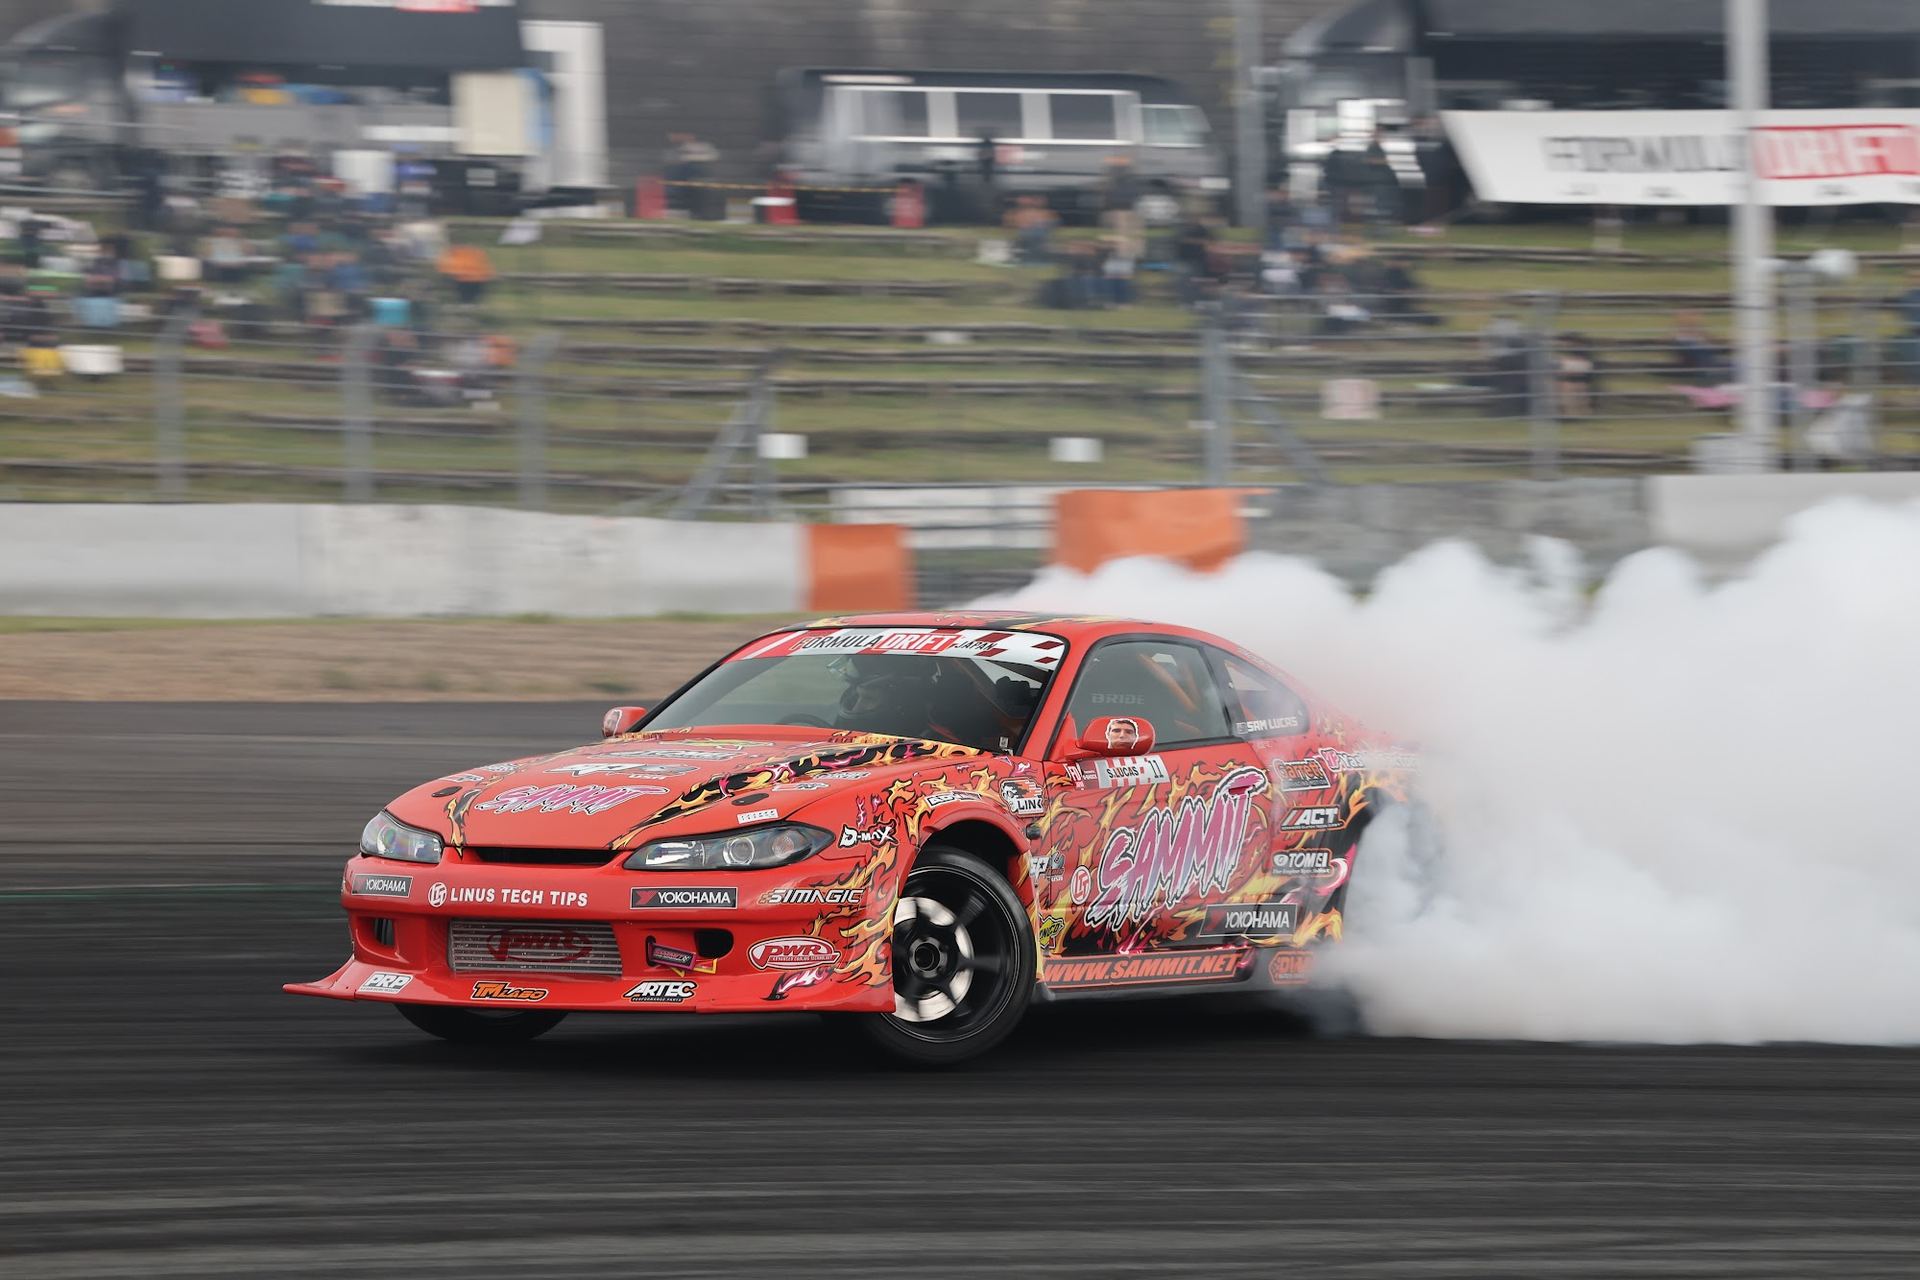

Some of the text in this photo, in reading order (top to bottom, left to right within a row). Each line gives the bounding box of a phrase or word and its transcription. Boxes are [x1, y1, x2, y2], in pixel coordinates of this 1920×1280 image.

[793, 632, 997, 652] FORMULA DRIFT JAPAN
[1091, 692, 1145, 705] BRIDE
[1246, 719, 1268, 733] SAM
[1268, 716, 1298, 730] LUCAS
[1106, 765, 1140, 779] S.LUCAS
[1148, 759, 1164, 779] 11
[1274, 759, 1326, 781] Garrett
[1293, 807, 1339, 826] ACT
[1084, 766, 1268, 931] SAMMIT
[1288, 852, 1329, 868] TOMEI
[366, 878, 406, 893] YOKOHAMA
[450, 887, 495, 903] LINUS
[501, 888, 544, 905] TECH
[550, 890, 588, 907] TIPS
[657, 890, 731, 904] YOKOHAMA
[768, 888, 864, 904] SIMAGIC
[1224, 910, 1290, 929] YOKOHAMA
[759, 944, 824, 967] PWR
[1044, 953, 1242, 982] WWW.SAMMIT.NET
[363, 973, 411, 989] PRP
[625, 981, 697, 998] ARTEC
